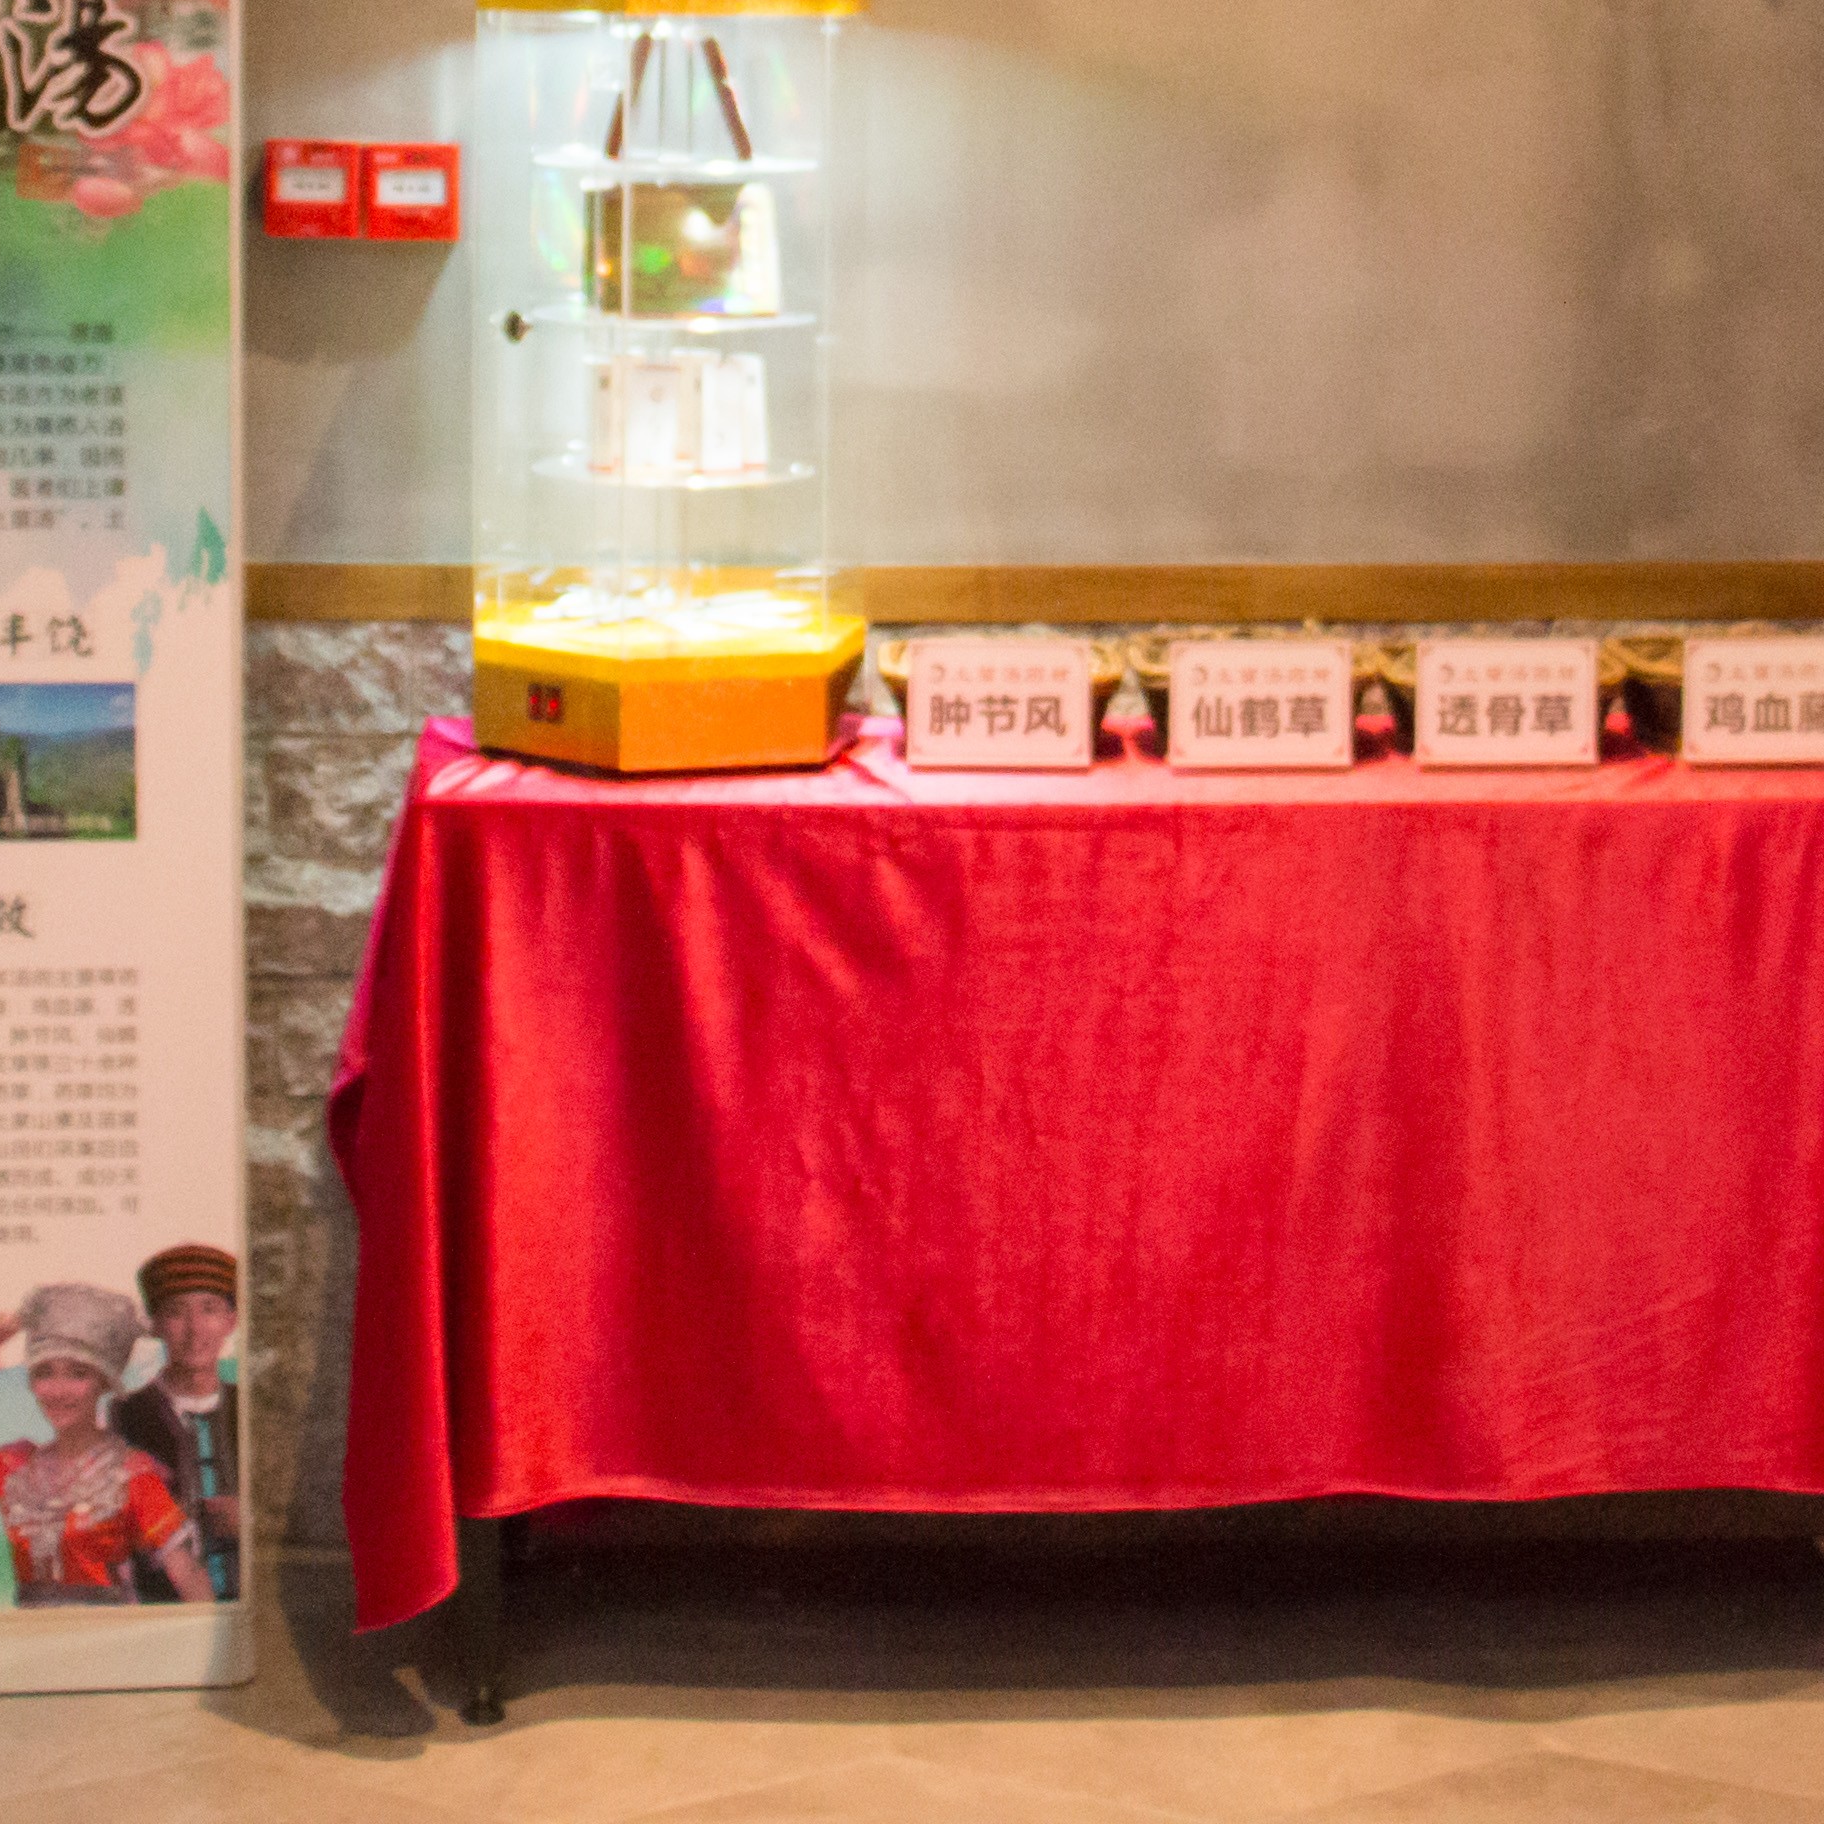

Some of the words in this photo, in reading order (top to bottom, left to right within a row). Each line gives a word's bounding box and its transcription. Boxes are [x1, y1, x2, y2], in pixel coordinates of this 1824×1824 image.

[929, 694, 1067, 737] 肿节风
[1191, 694, 1327, 738] 仙鹤草
[1438, 693, 1573, 737] 透骨草
